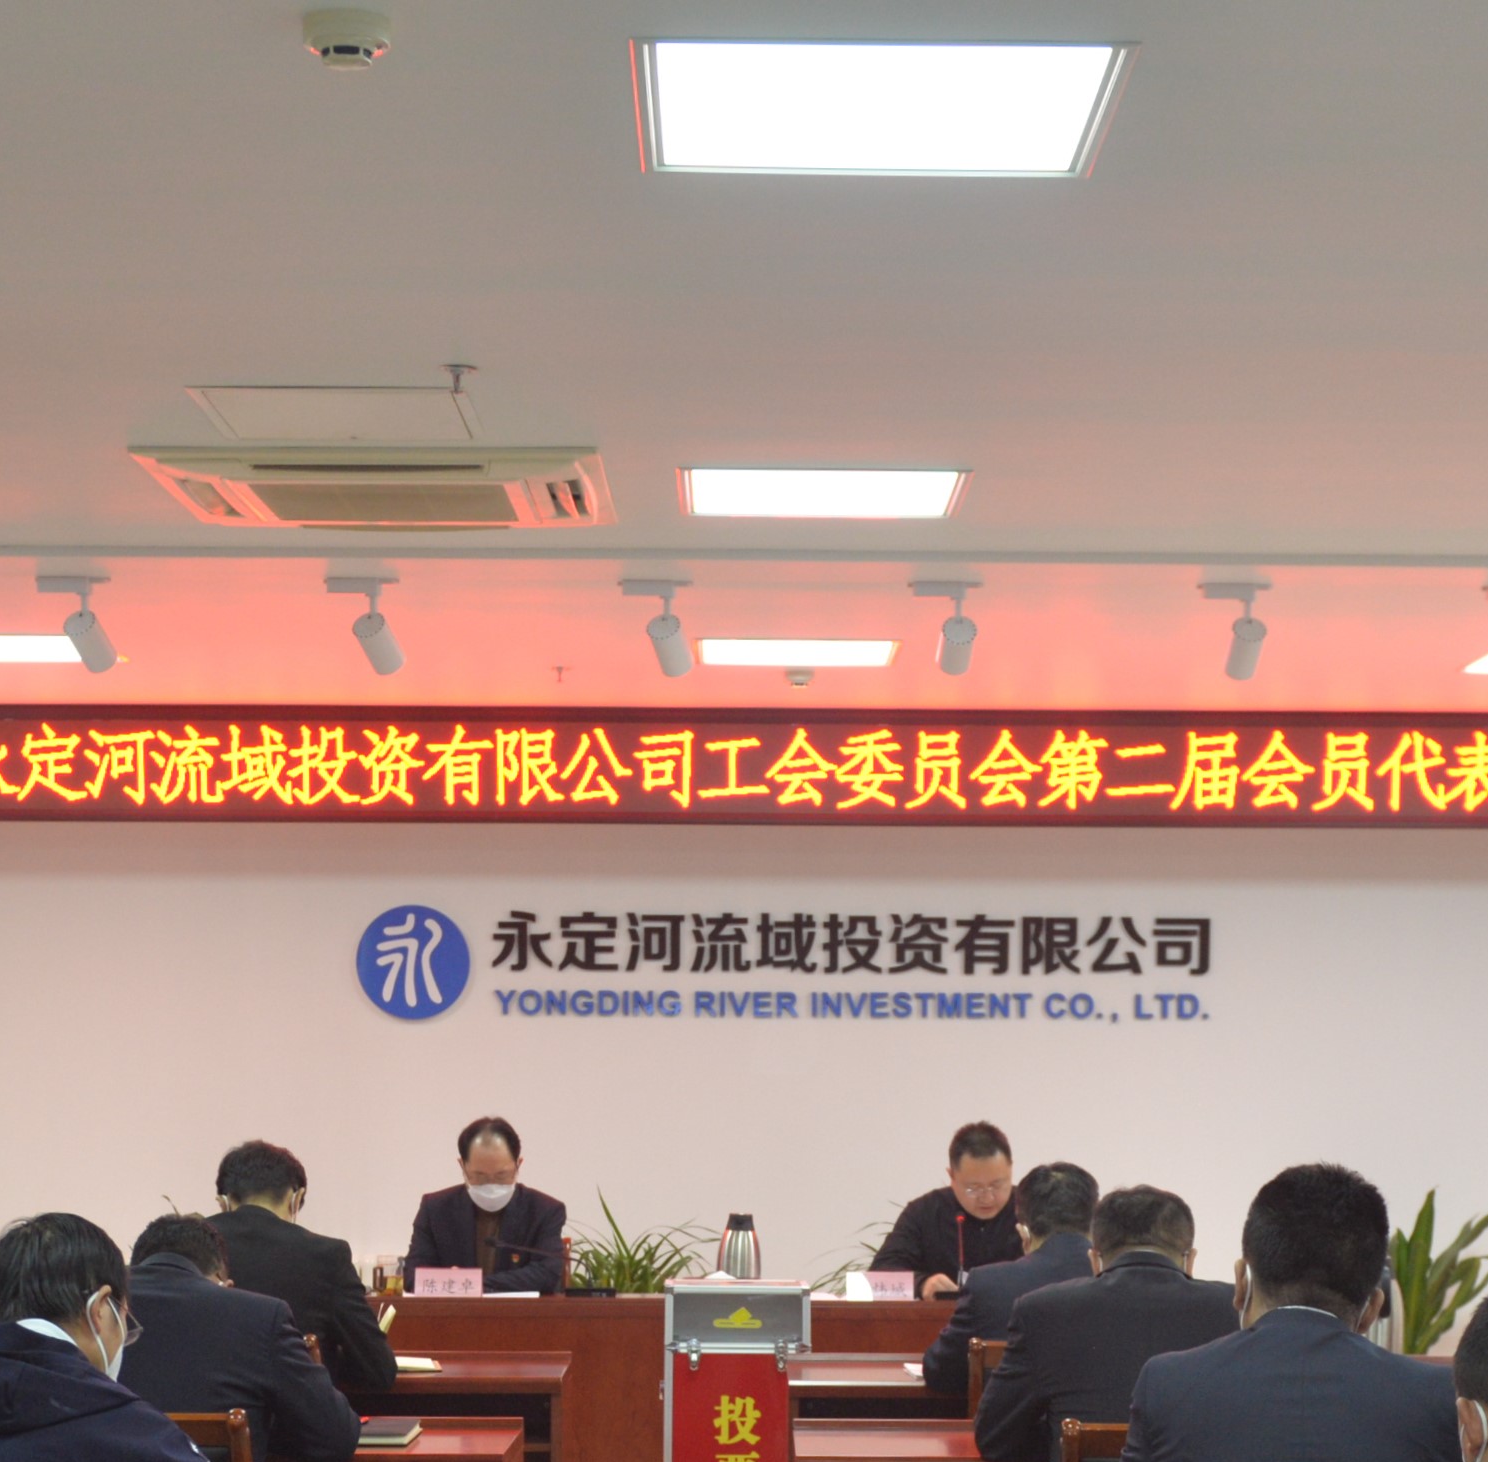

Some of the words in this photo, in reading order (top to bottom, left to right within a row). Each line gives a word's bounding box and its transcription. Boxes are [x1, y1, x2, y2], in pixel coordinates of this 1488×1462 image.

[491, 909, 1213, 977] 永定河流域投资有限公司
[494, 989, 682, 1017] YONGDING
[695, 991, 798, 1018] RIVER
[811, 991, 1033, 1020] INVESTMENT
[1134, 993, 1210, 1021] LTD.
